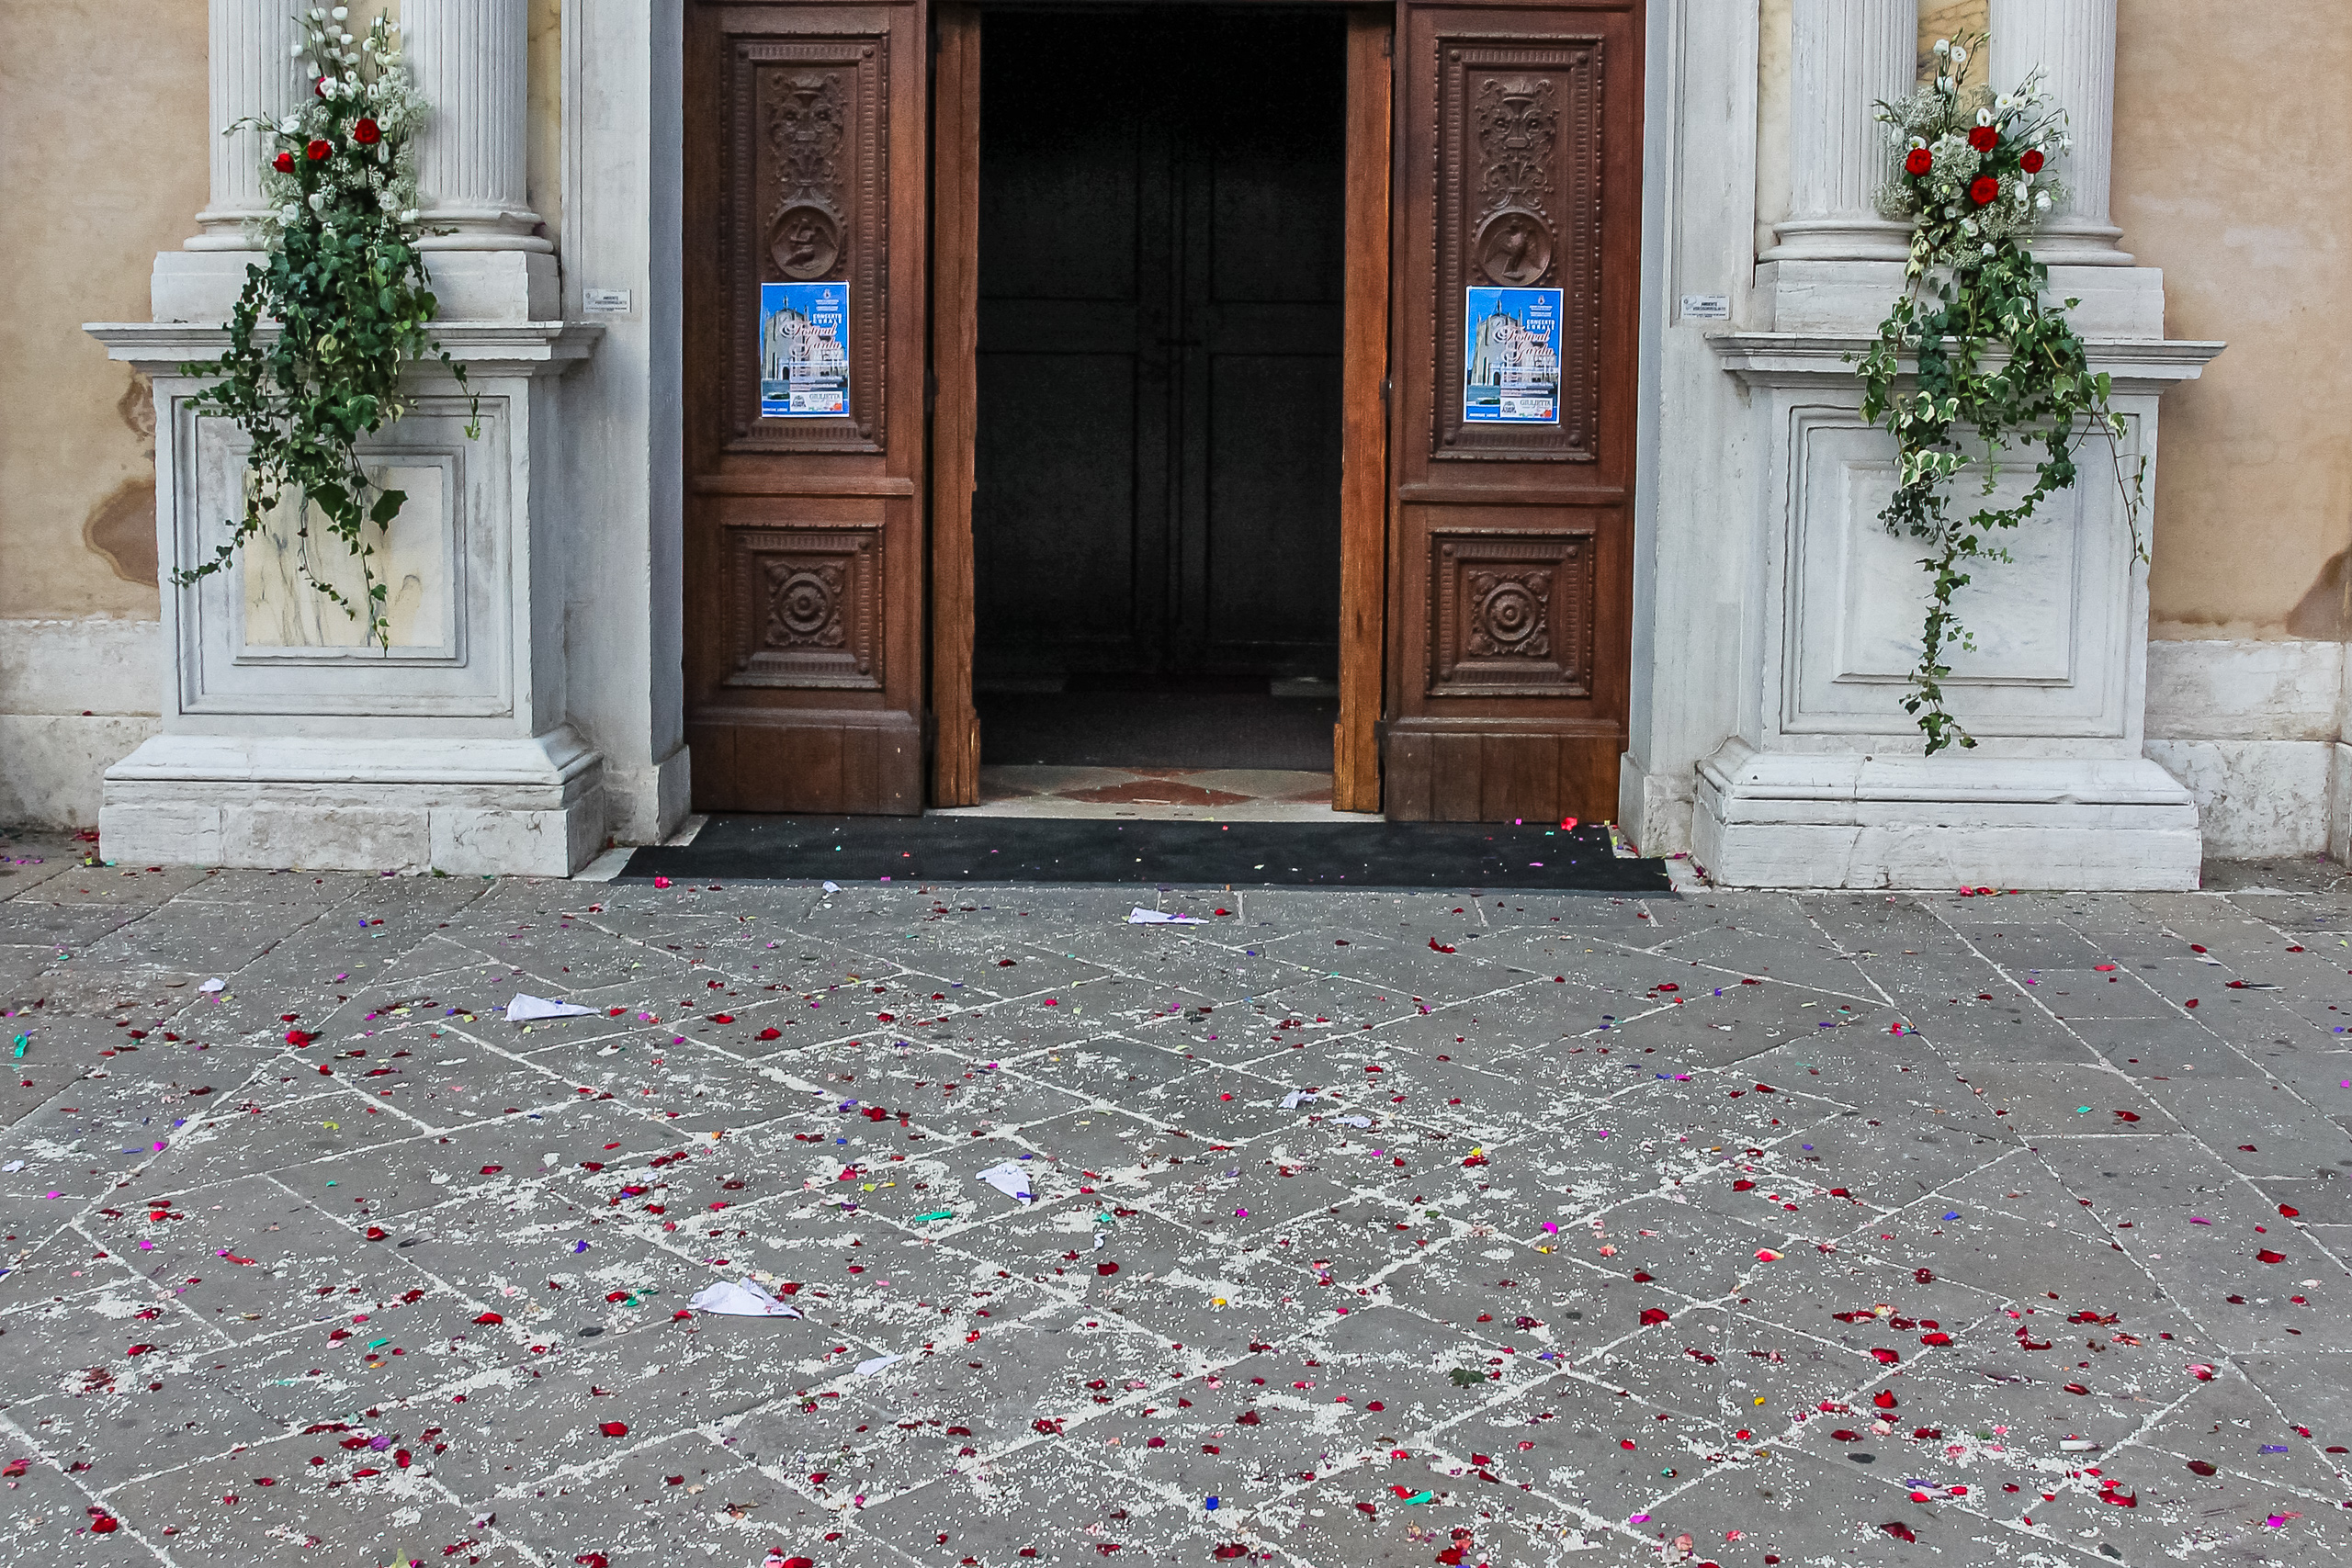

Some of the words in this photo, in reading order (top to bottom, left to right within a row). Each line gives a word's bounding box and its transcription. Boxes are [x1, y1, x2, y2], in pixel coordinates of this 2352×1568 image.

[780, 321, 838, 338] Festival
[1493, 325, 1551, 343] Festival
[789, 336, 842, 357] Garda
[1501, 343, 1555, 363] Garda
